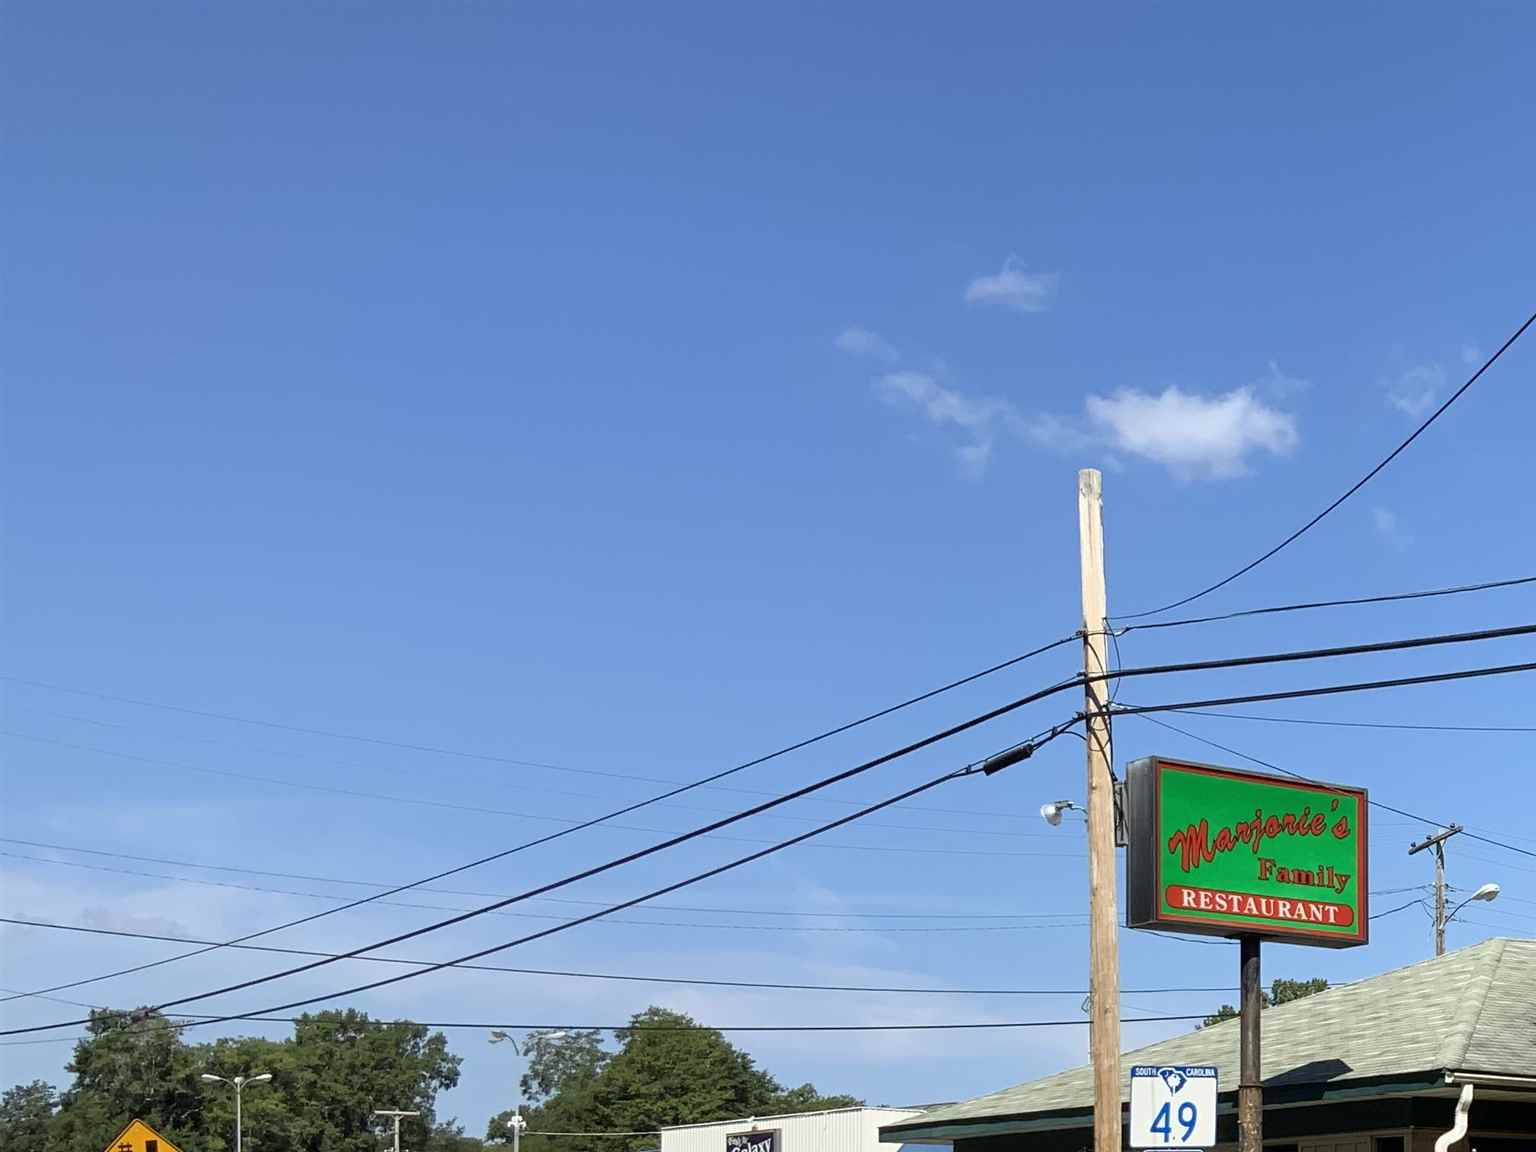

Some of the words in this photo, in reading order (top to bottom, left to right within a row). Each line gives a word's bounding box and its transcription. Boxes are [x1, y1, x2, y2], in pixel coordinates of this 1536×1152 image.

[1168, 799, 1350, 873] Marjorie's
[1258, 857, 1351, 894] Family
[1180, 888, 1339, 924] RESTAURANT
[1135, 1067, 1157, 1076] SOUTH
[1186, 1068, 1215, 1077] CAROLINA
[1150, 1101, 1198, 1143] 49
